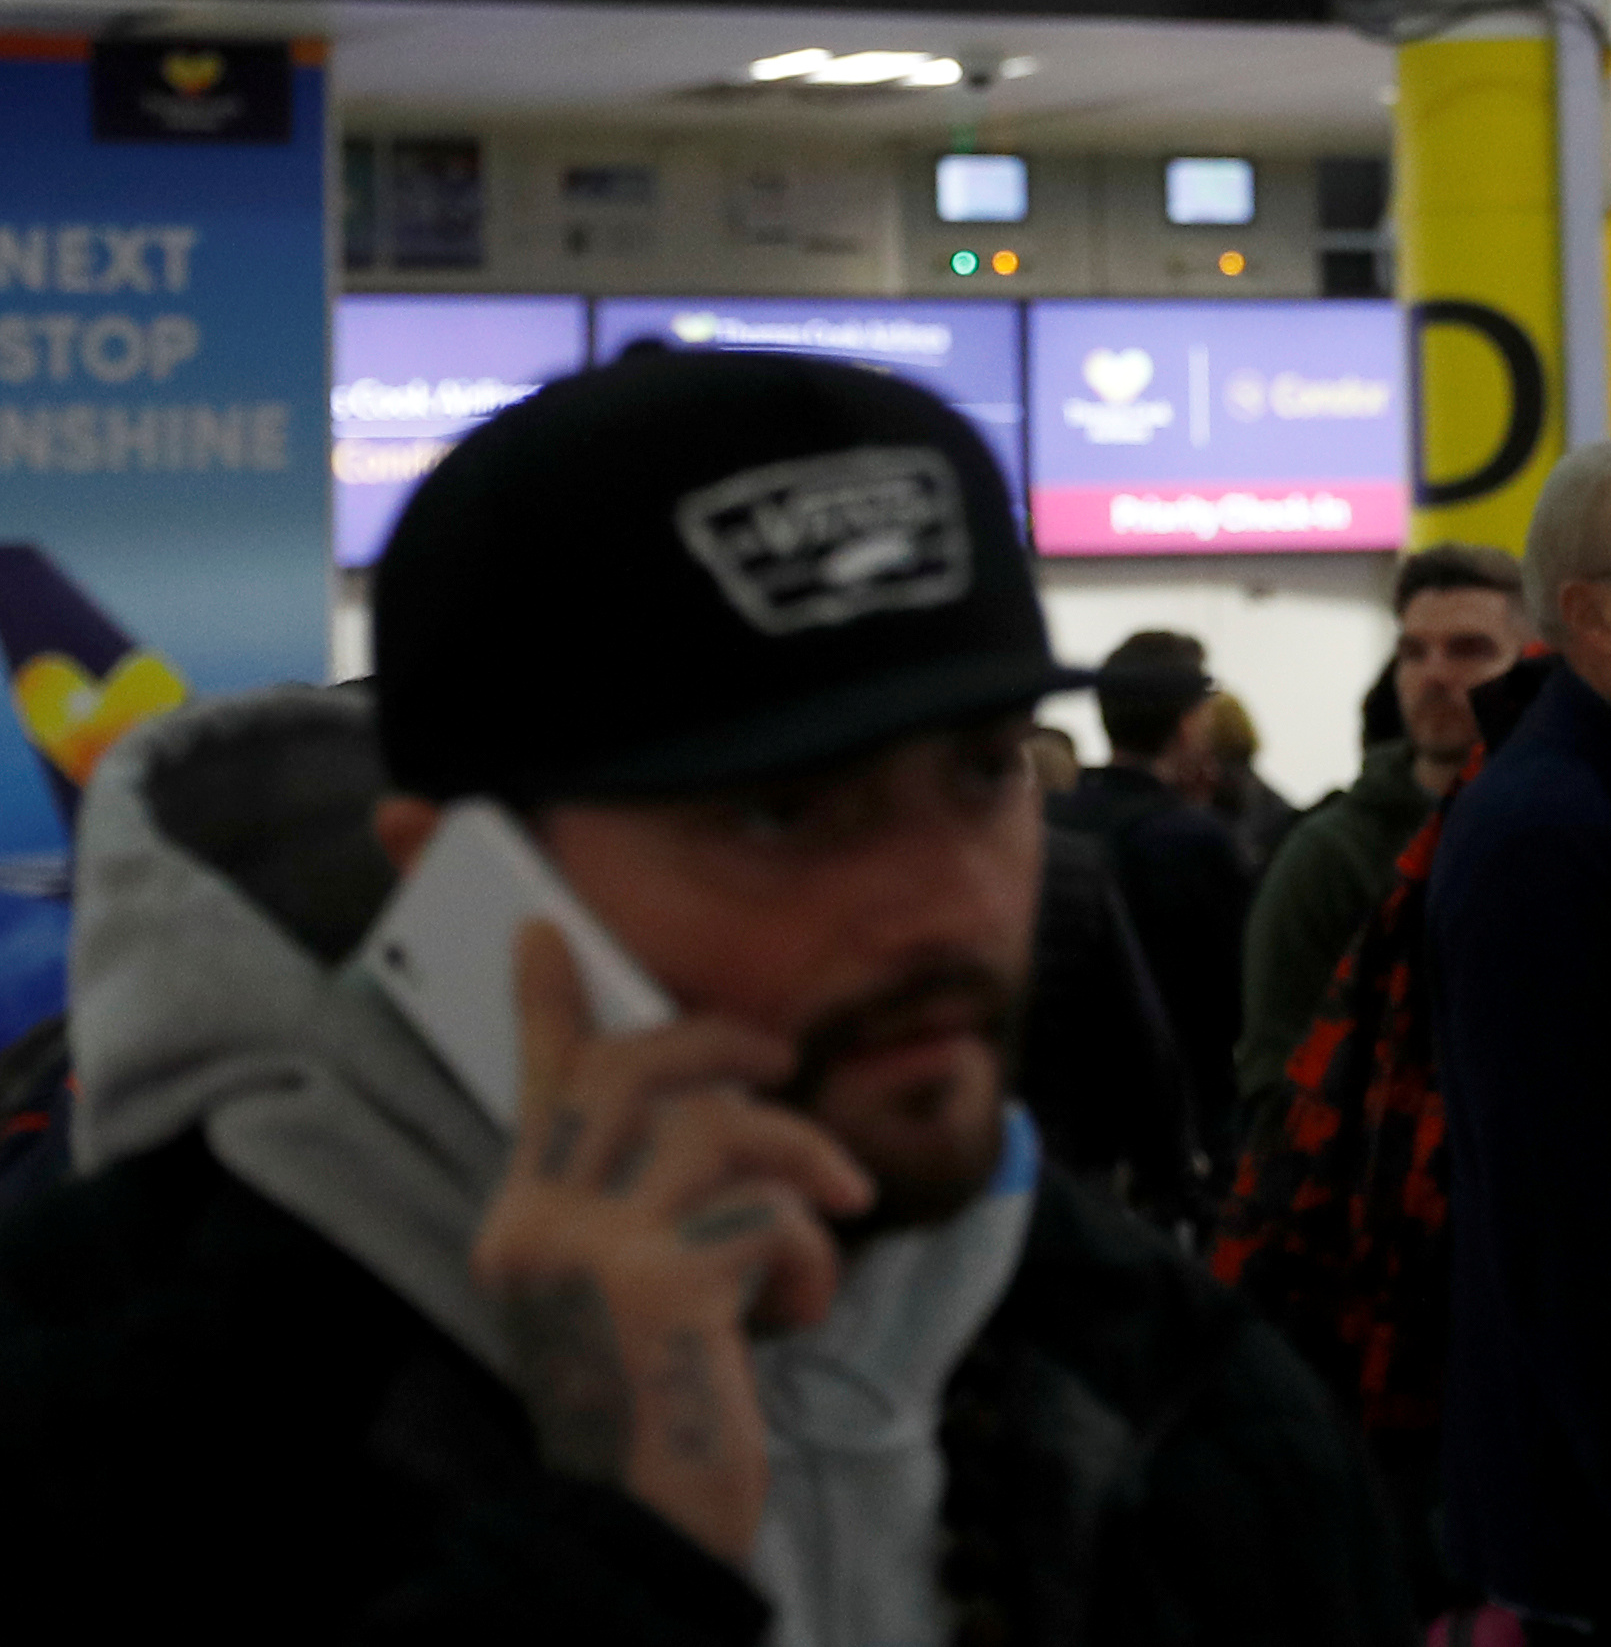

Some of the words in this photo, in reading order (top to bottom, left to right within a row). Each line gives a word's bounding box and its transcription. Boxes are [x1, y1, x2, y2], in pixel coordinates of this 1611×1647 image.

[0, 224, 198, 293] NEXT
[0, 313, 198, 383] STOP
[1413, 298, 1546, 507] D
